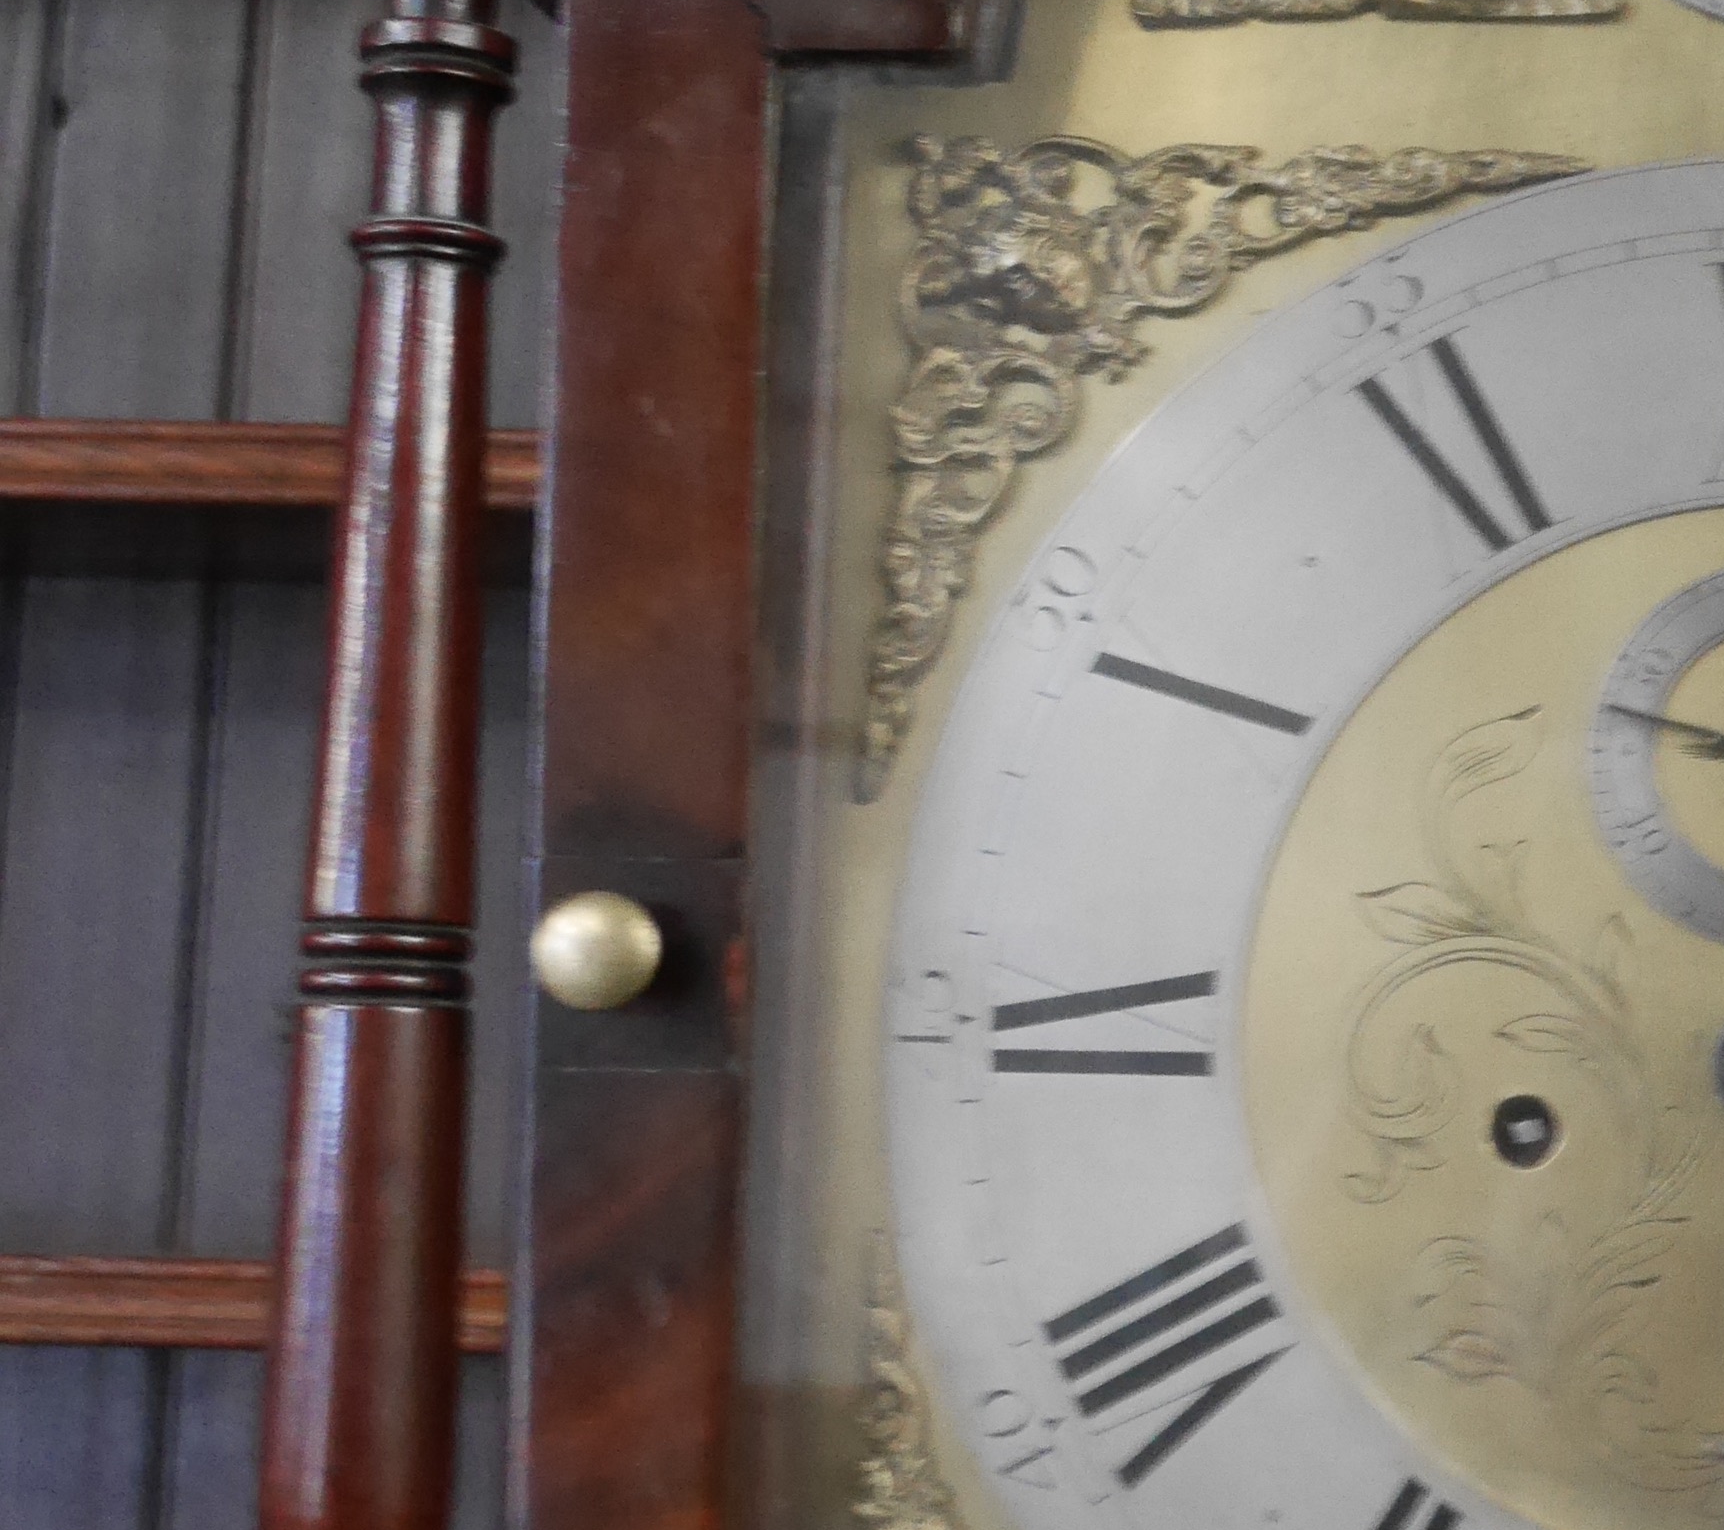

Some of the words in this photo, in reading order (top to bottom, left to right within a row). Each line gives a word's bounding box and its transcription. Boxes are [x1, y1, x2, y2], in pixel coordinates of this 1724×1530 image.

[1333, 246, 1427, 339] 55
[1343, 323, 1577, 561] XI
[1007, 543, 1100, 654] 50
[986, 960, 1221, 1078] IX
[1038, 1217, 1301, 1492] VIII
[976, 1386, 1057, 1492] 40
